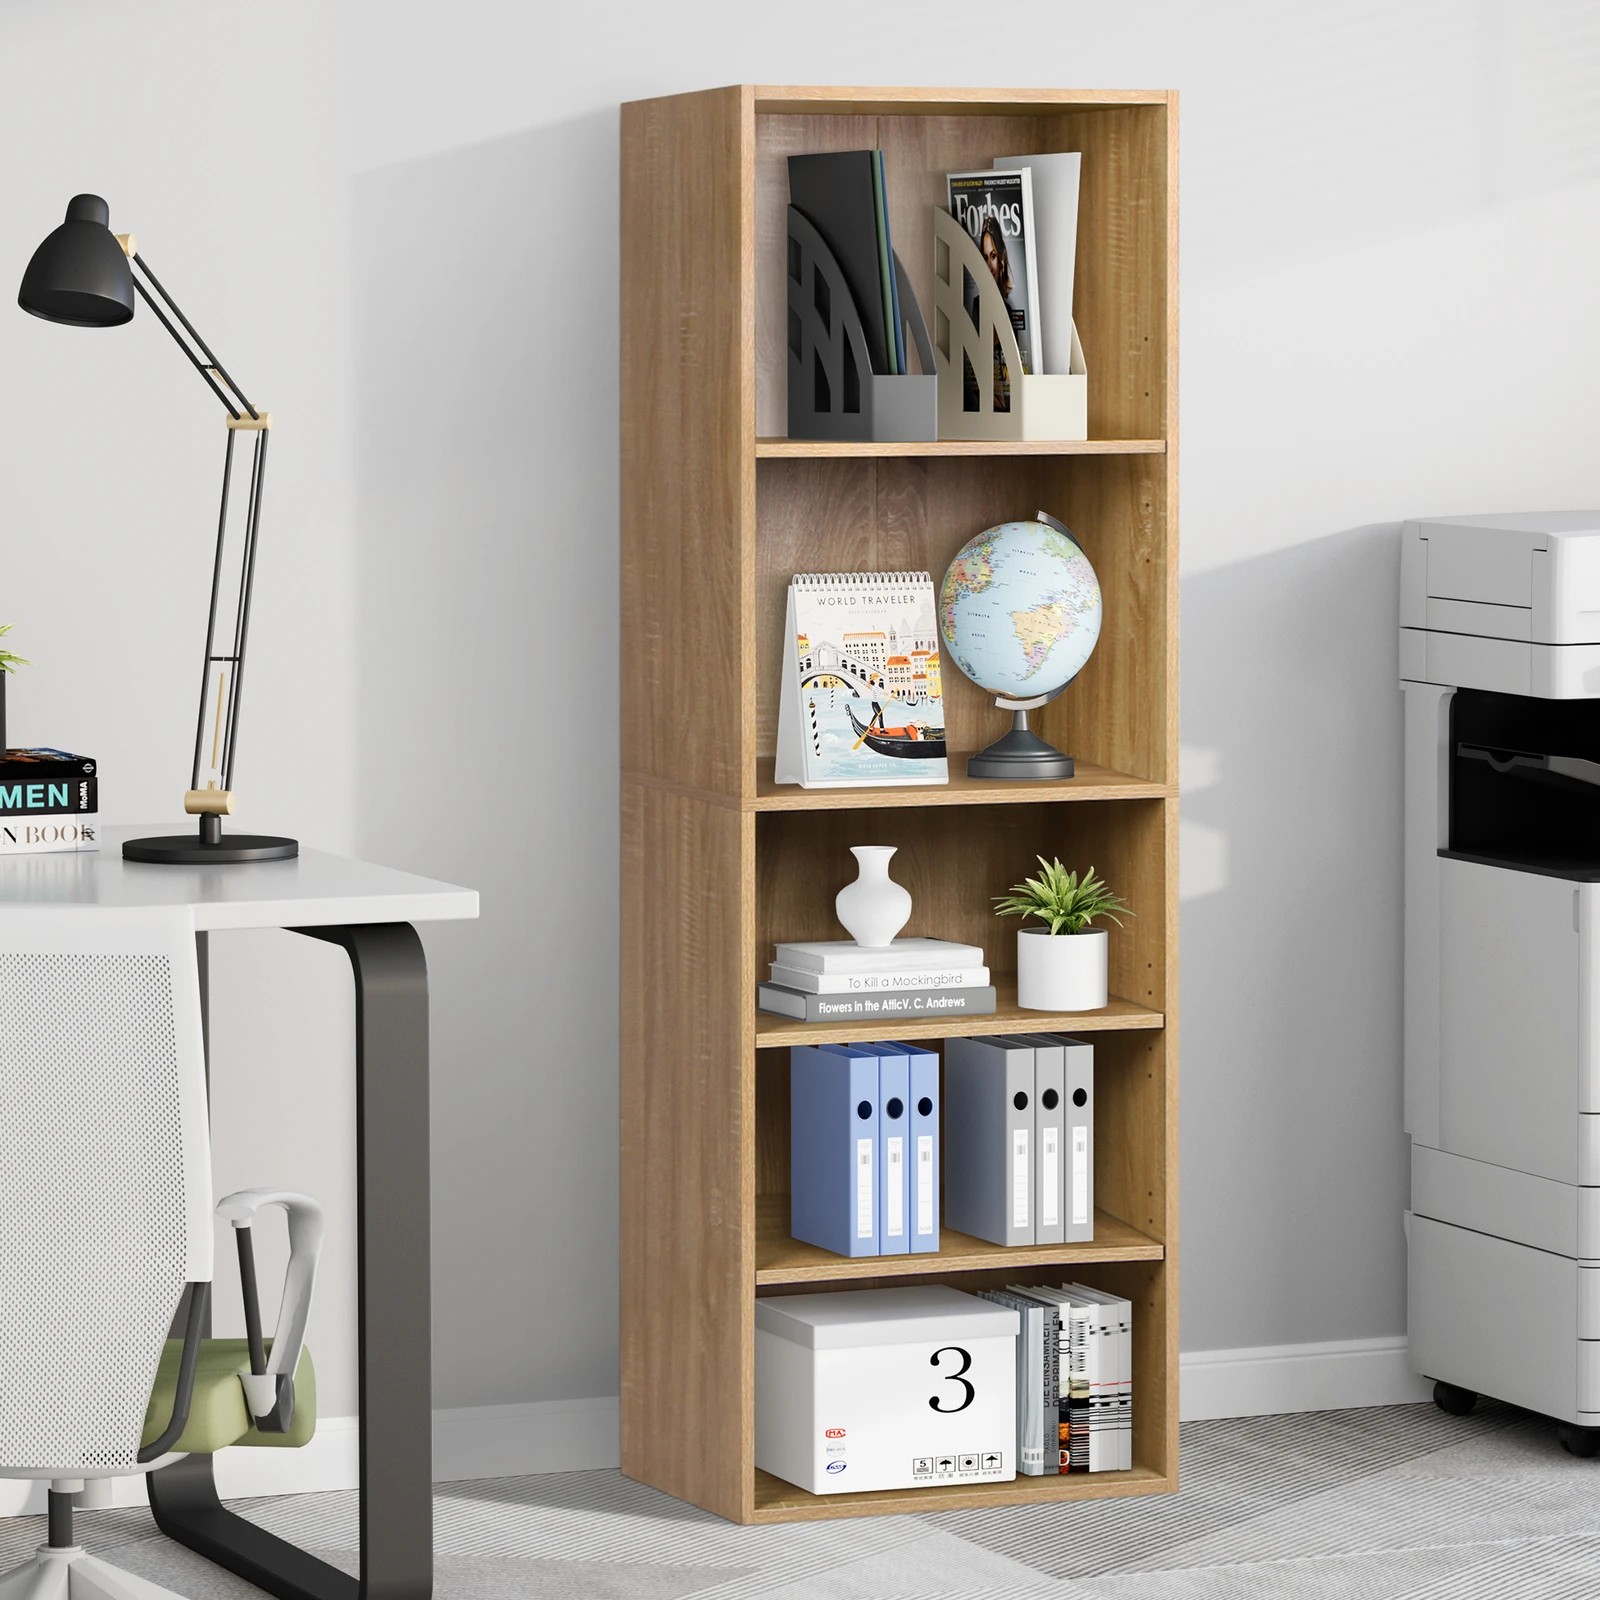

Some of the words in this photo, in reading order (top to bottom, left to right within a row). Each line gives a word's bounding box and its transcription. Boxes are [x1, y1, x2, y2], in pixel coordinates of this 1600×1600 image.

[953, 192, 1021, 237] Forbes
[817, 597, 857, 606] WORLD
[862, 595, 916, 605] TRAVELER
[80, 781, 88, 809] MoMA
[26, 824, 95, 844] BOOK
[849, 978, 861, 989] To
[864, 976, 879, 988] Kill
[881, 979, 889, 988] a
[893, 973, 963, 988] Mockingbird
[819, 1001, 852, 1014] Flowers
[854, 1001, 863, 1013] in
[864, 999, 880, 1012] the
[913, 997, 924, 1010] C.
[926, 996, 966, 1009] Andrews
[929, 1346, 975, 1413] 3
[919, 1459, 927, 1468] 5
